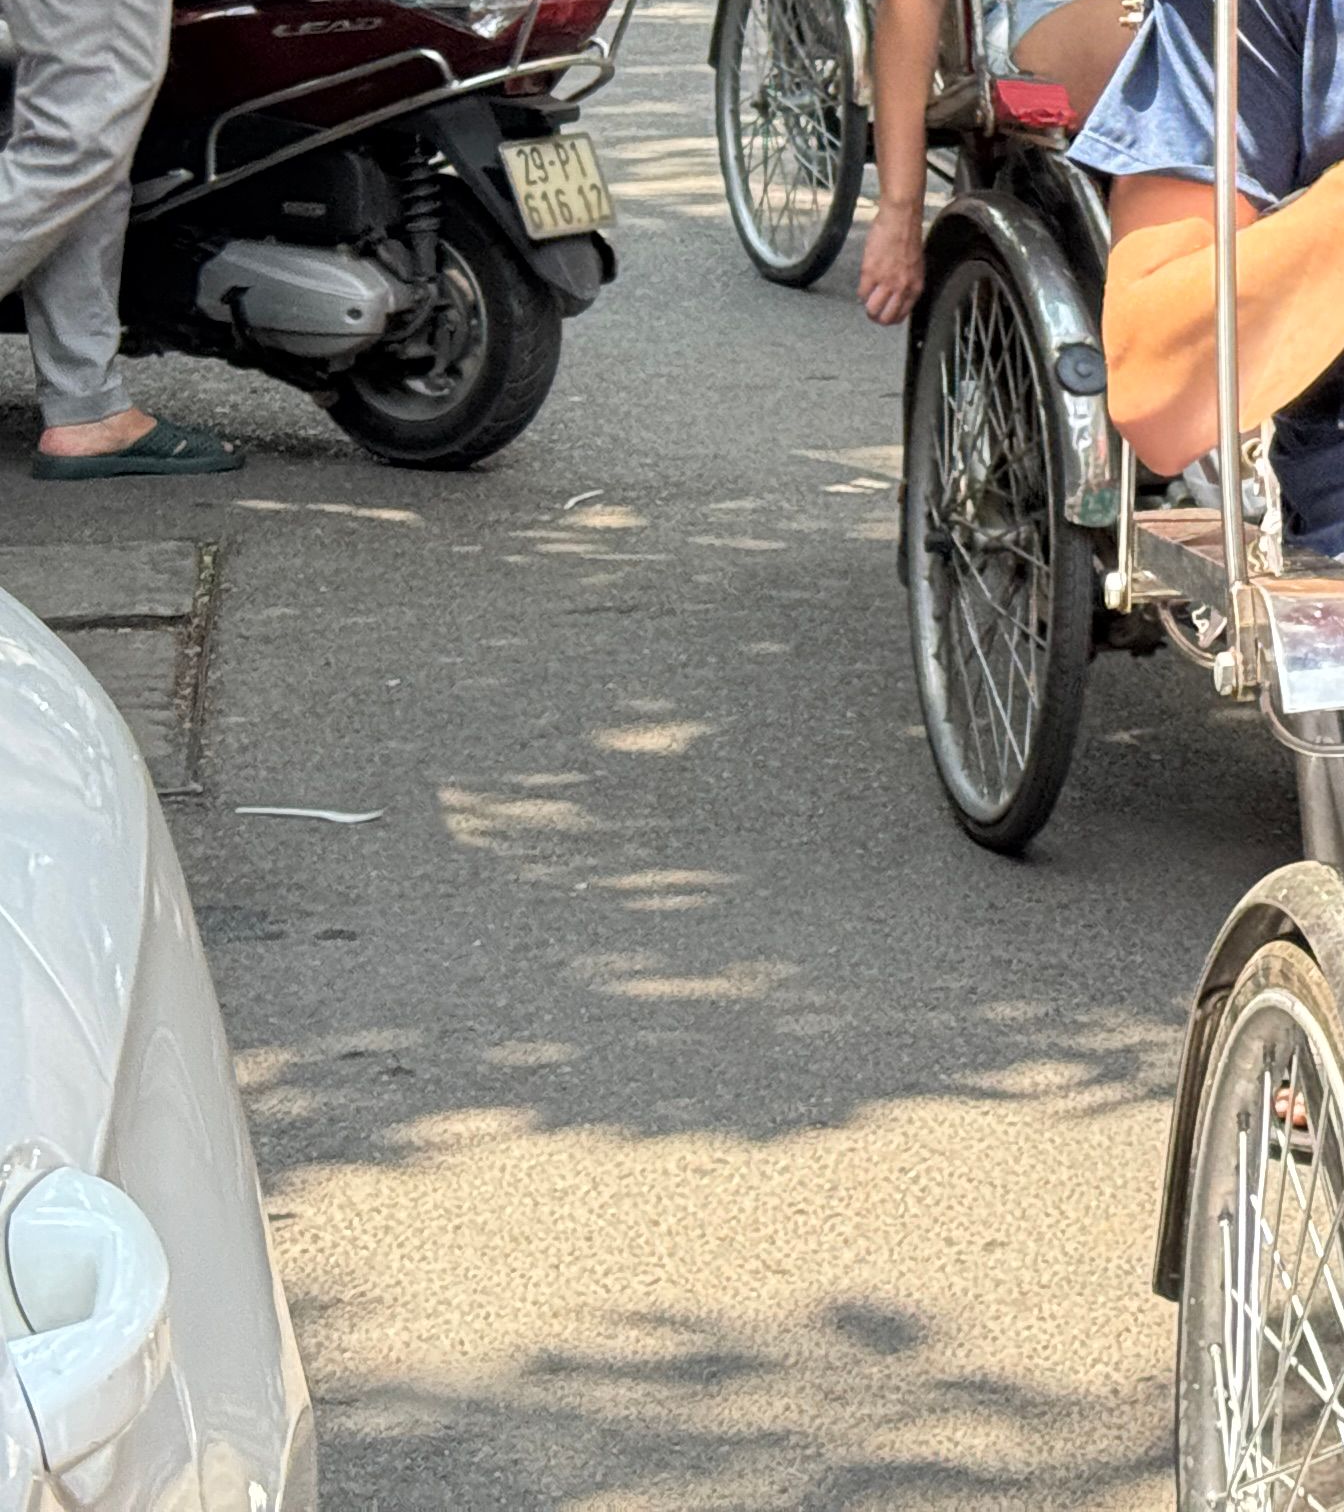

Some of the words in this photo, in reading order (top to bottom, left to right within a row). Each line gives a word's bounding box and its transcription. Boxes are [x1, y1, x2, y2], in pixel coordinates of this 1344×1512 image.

[271, 16, 384, 38] LEAD
[515, 140, 588, 186] 29-P1
[523, 182, 611, 230] 616.12
